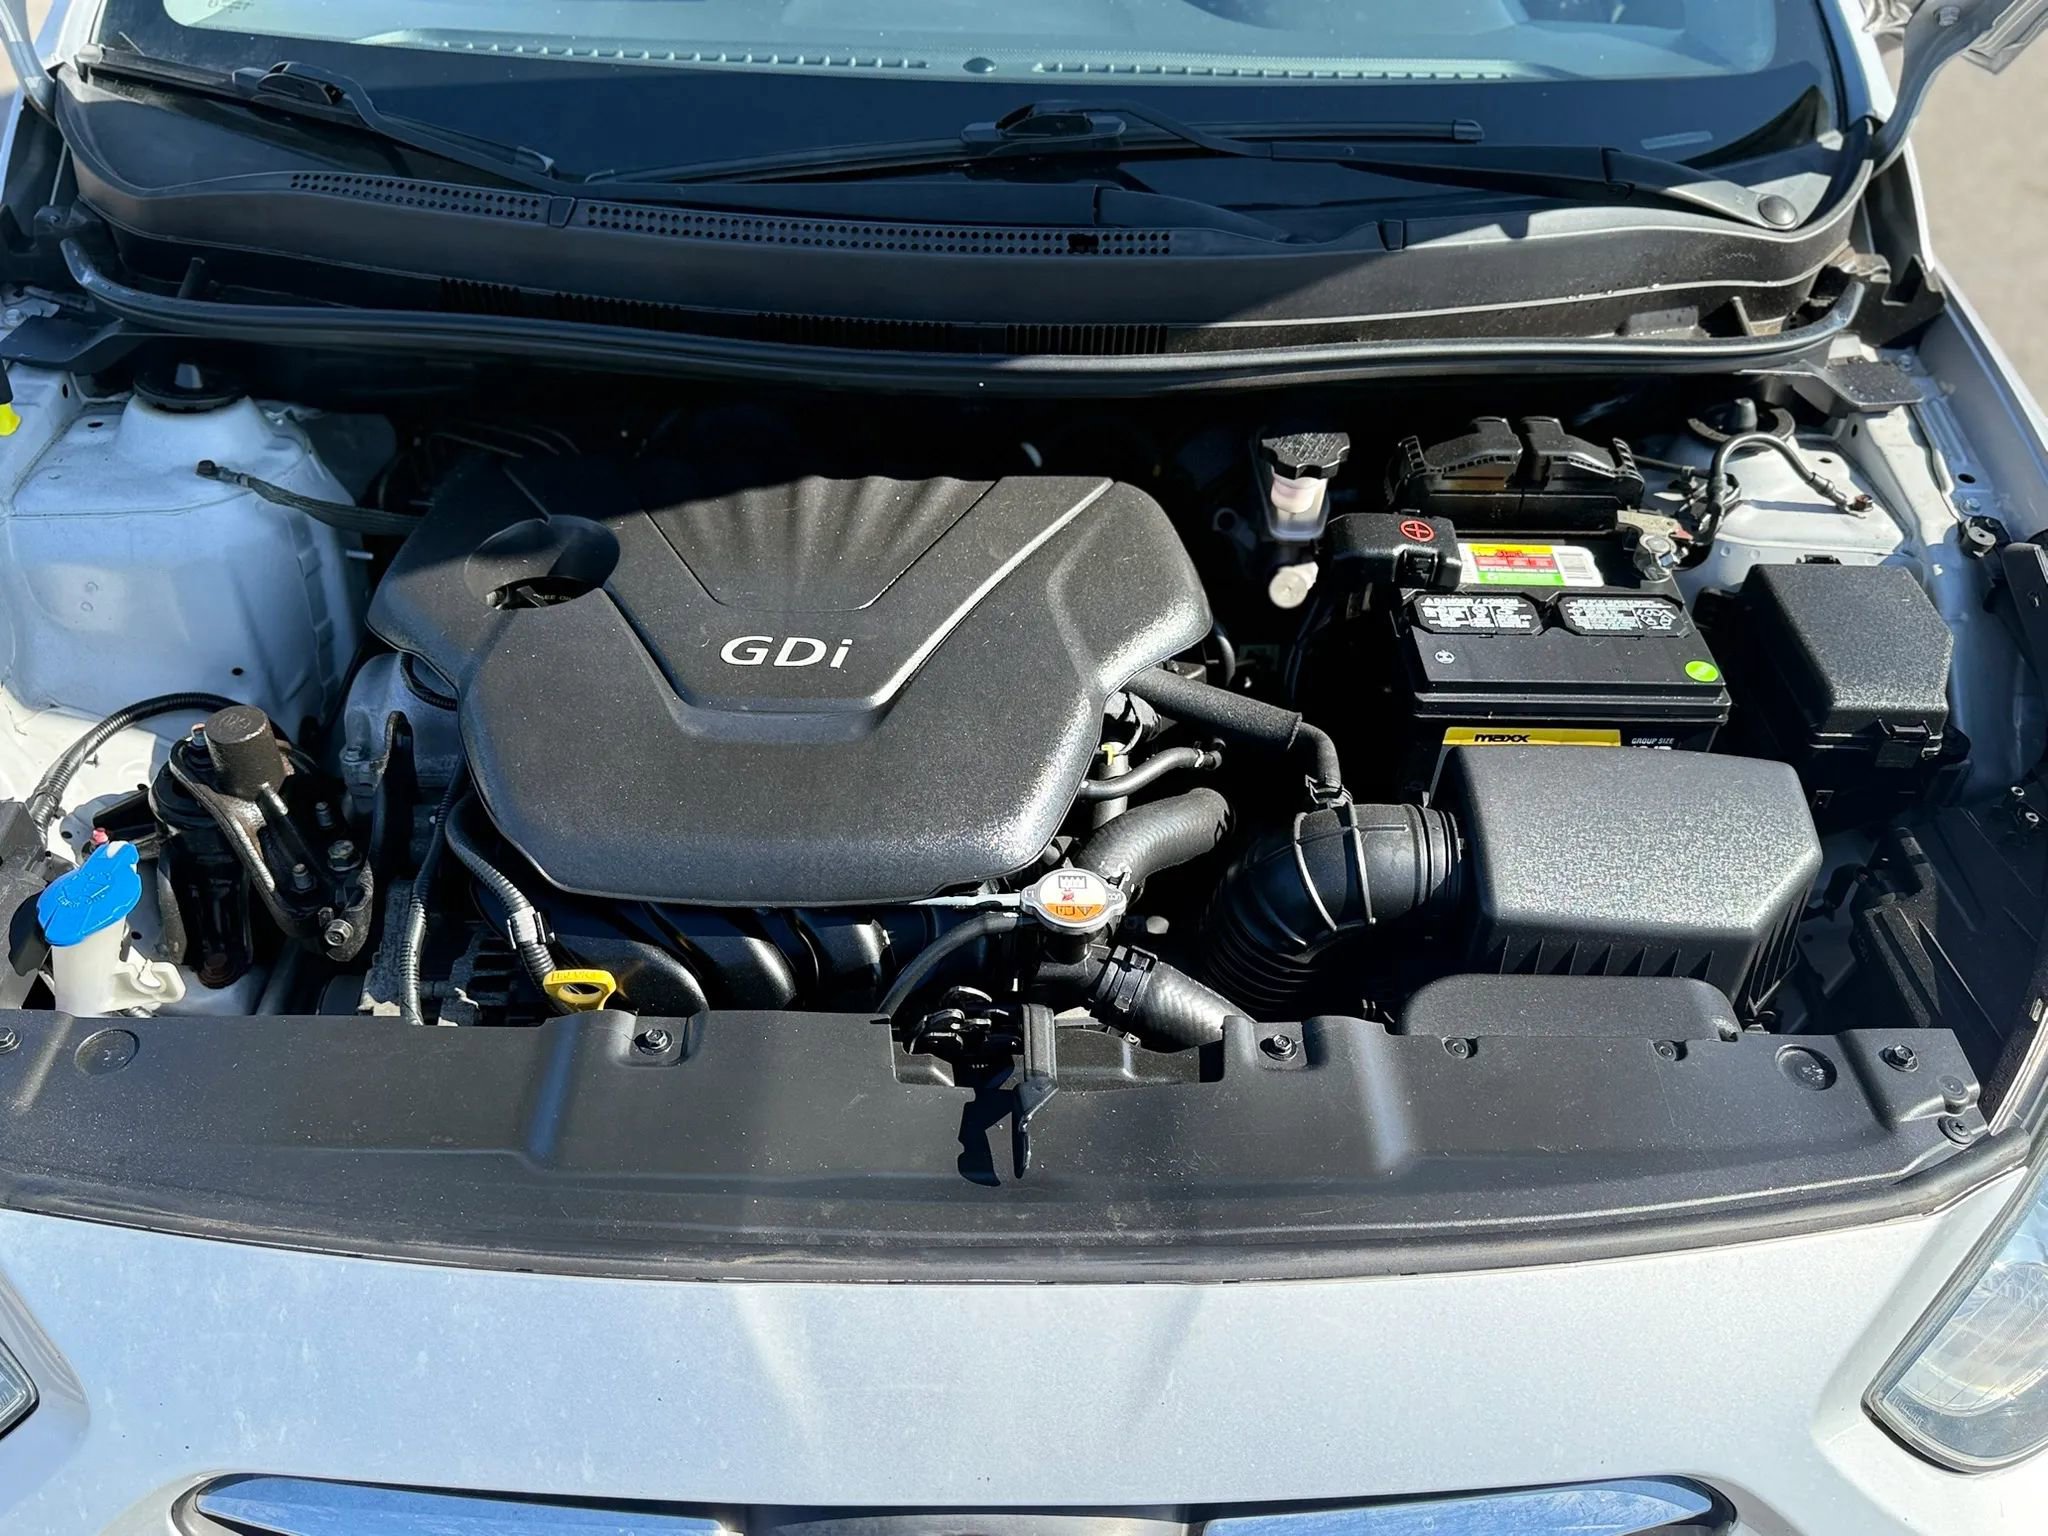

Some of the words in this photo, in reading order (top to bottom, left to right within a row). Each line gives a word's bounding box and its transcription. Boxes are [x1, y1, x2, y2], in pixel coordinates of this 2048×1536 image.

[720, 635, 853, 669] GDi
[1474, 734, 1531, 743] maxx
[1631, 737, 1657, 745] GROUP
[1658, 737, 1675, 745] SIZE
